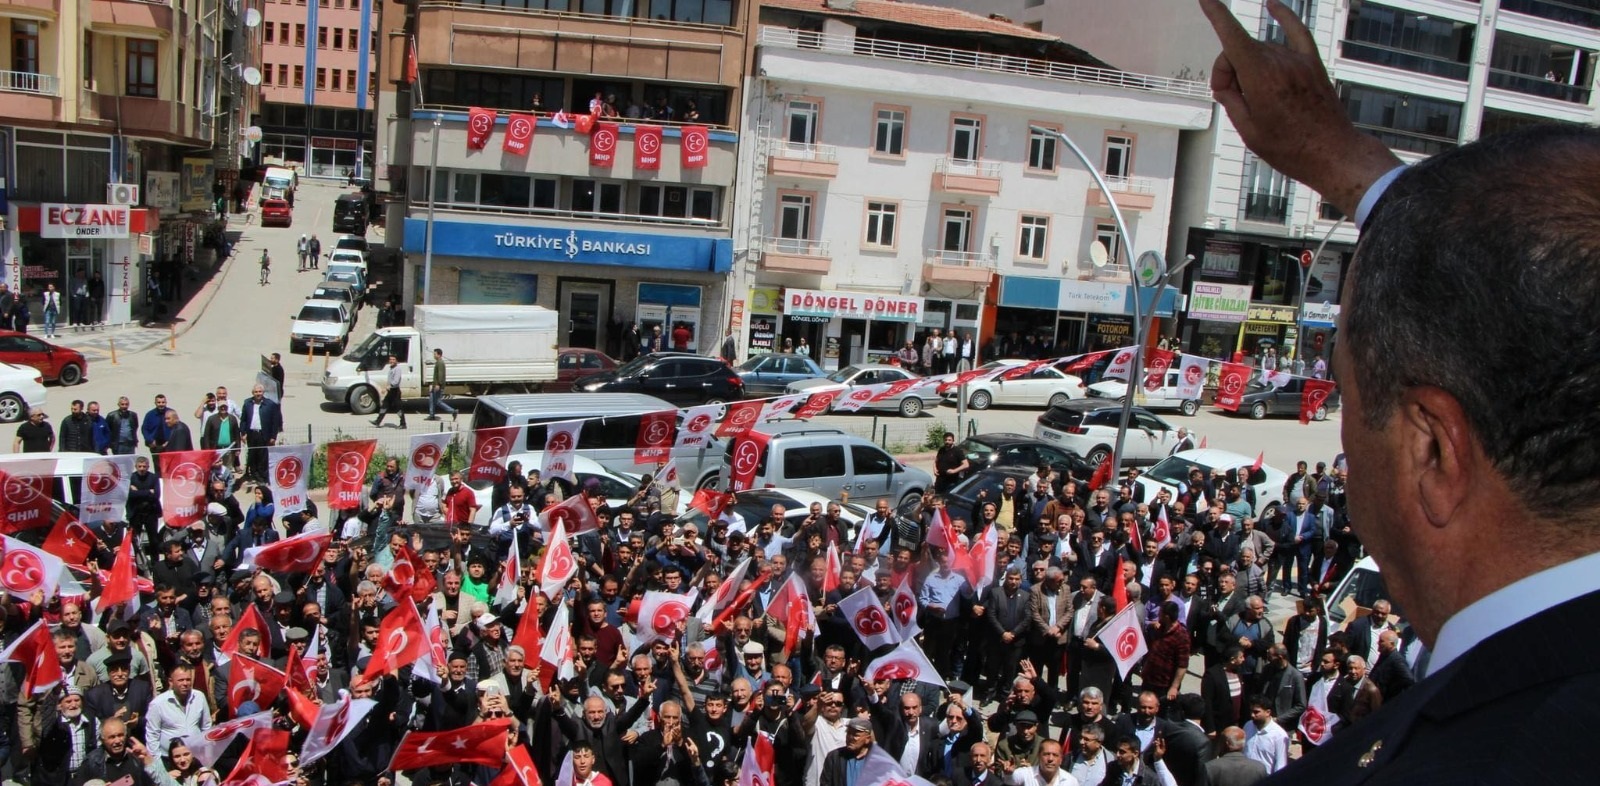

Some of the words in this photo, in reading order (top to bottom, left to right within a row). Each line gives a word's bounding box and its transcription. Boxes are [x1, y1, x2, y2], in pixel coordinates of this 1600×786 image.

[508, 139, 525, 149] MHP
[594, 153, 611, 161] MHP
[48, 207, 126, 225] ECZANE
[76, 227, 100, 235] ÖNDER
[494, 233, 562, 250] TÜRKİYE
[582, 240, 651, 256] BANKASI
[792, 291, 858, 310] DÖNGEL
[864, 296, 918, 314] DÖNER
[1102, 334, 1122, 344] FAKS
[682, 436, 703, 445] MHP
[641, 449, 664, 457] MHP
